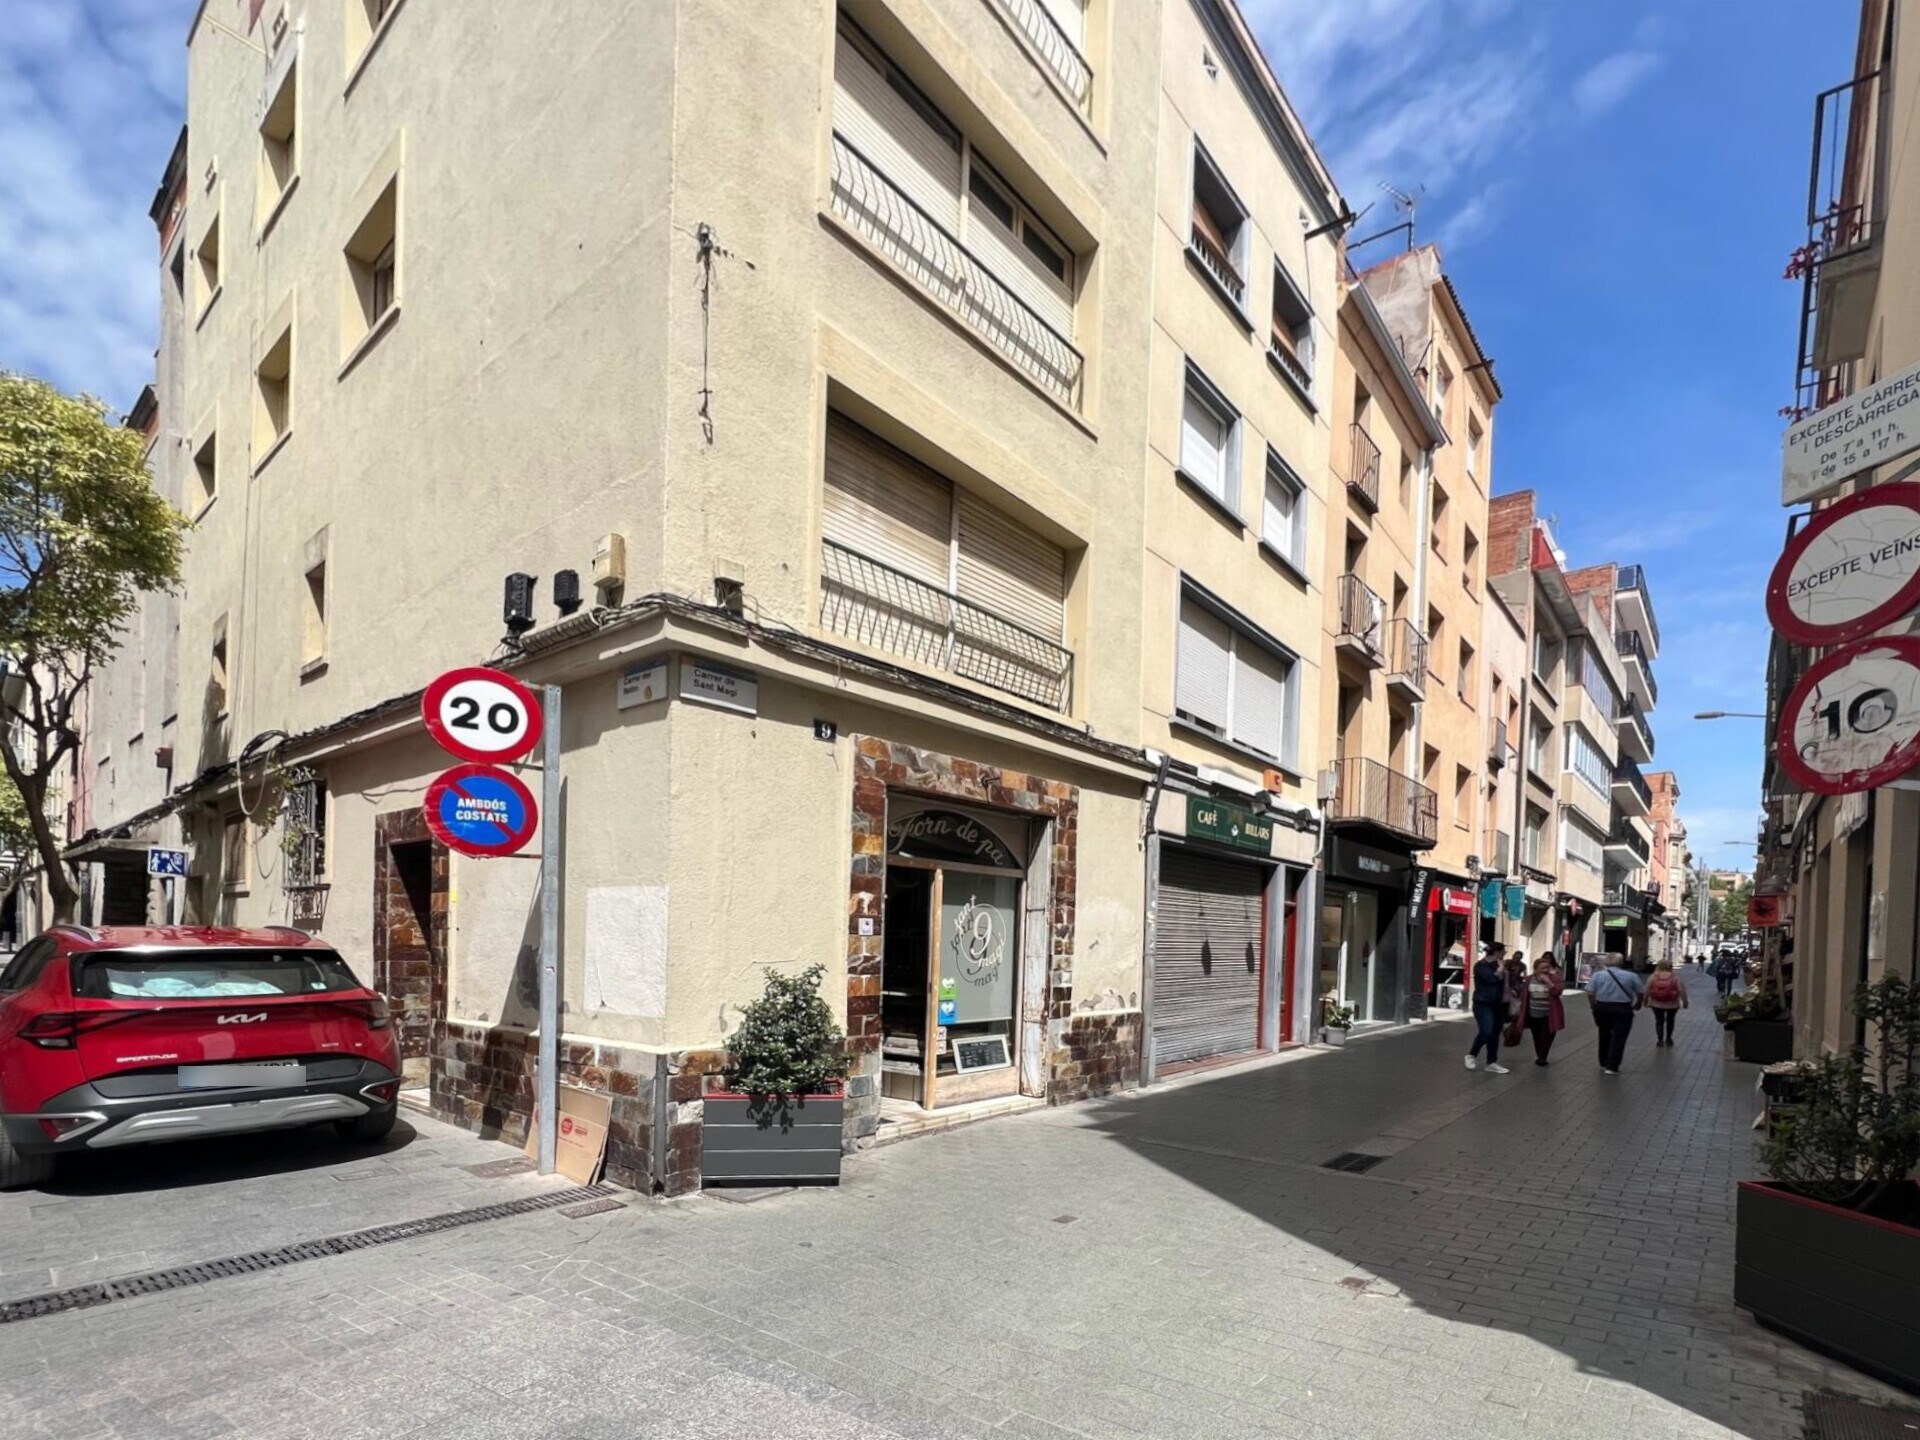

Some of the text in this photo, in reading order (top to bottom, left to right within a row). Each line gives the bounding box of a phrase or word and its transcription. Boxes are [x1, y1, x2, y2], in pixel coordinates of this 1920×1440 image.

[1790, 405, 1854, 447] EXCEPTE
[1815, 388, 1920, 449] DESCÀRREGA
[1820, 451, 1837, 464] De
[1871, 429, 1881, 440] 11
[1821, 464, 1836, 476] de
[1843, 453, 1856, 466] 15
[1862, 448, 1870, 458] a
[1878, 436, 1890, 450] 17
[1788, 556, 1861, 597] EXCEPTE
[693, 679, 714, 692] Sant
[694, 669, 736, 686] Carrer de
[450, 696, 519, 734] 20
[821, 723, 832, 739] 9
[1819, 688, 1897, 741] 10
[455, 810, 509, 823] COSTATS
[457, 797, 507, 811] AMBDÓS
[888, 811, 1004, 866] Forn de pa
[1412, 870, 1428, 903] MISAKO
[970, 911, 992, 956] 9
[217, 1012, 267, 1025] KIA
